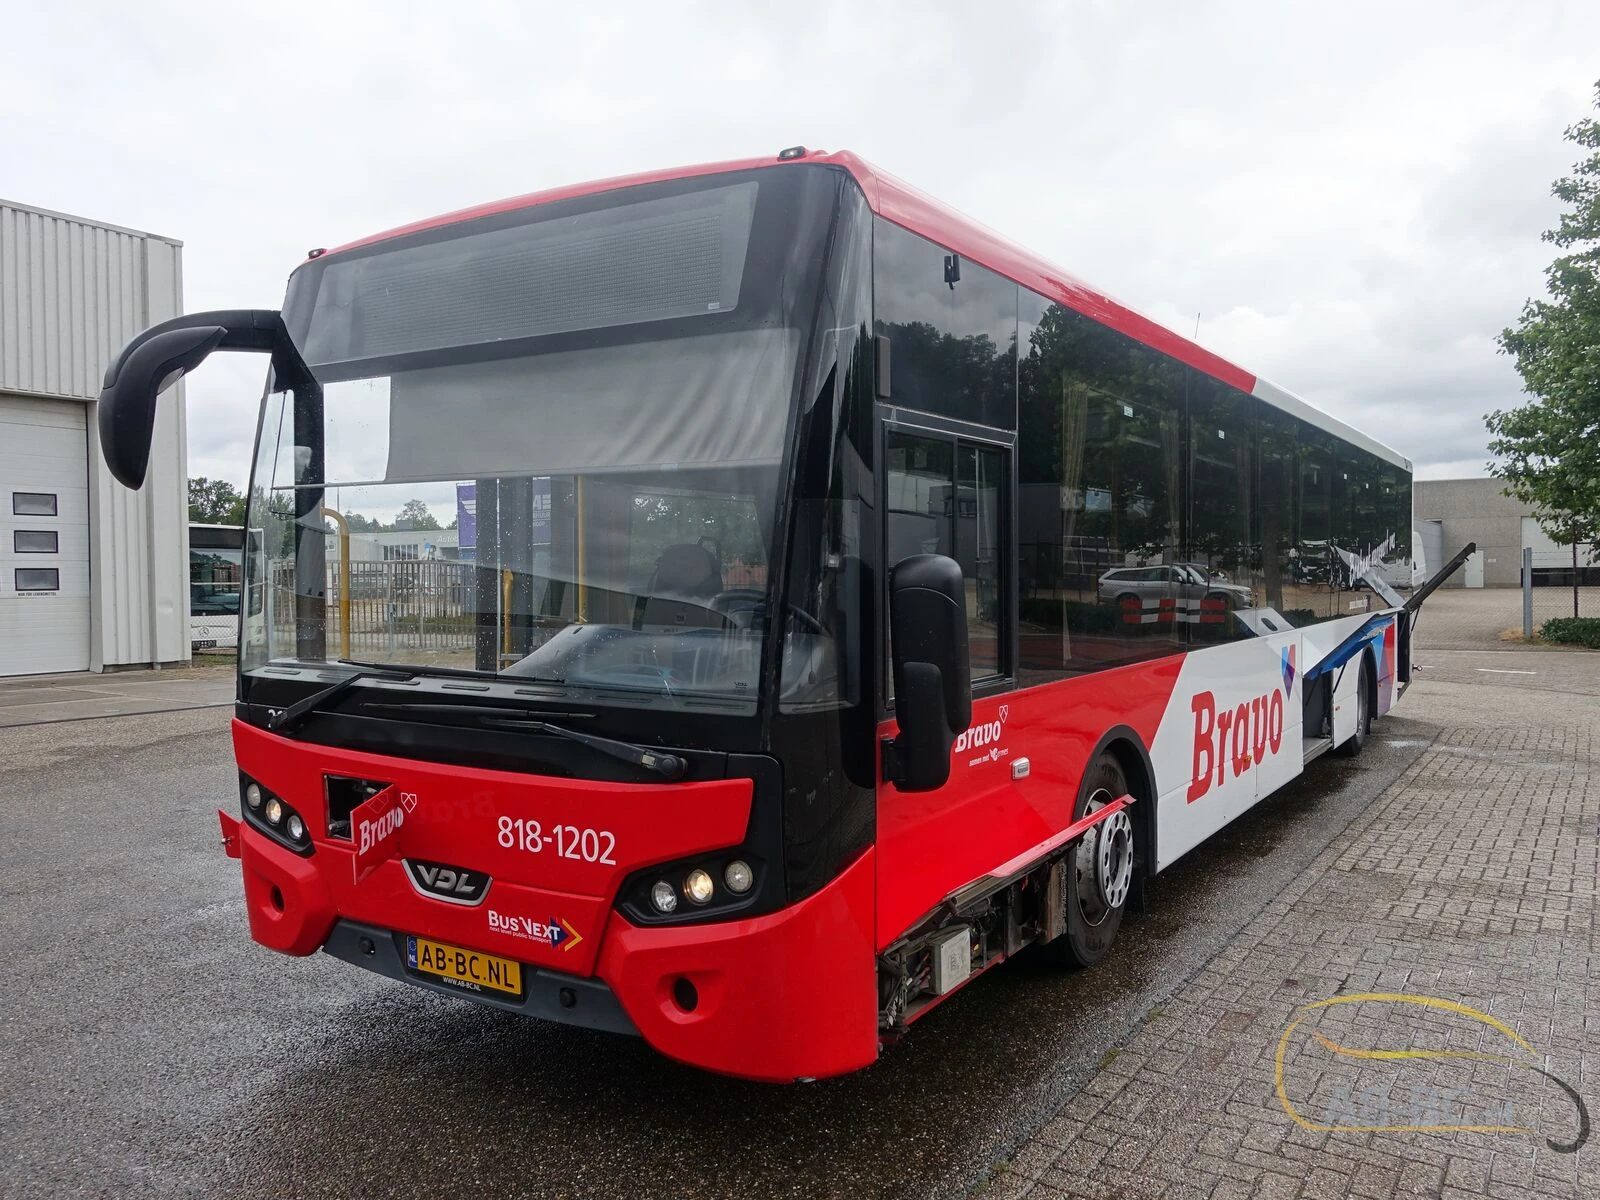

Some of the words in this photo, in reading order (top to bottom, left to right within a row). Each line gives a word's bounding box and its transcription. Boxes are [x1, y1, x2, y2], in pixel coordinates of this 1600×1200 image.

[955, 720, 1002, 753] Bravo
[1186, 687, 1284, 805] Bravo
[358, 806, 405, 856] Bravo
[497, 814, 617, 866] 818-1202
[416, 863, 477, 895] VDL
[500, 928, 512, 936] level
[512, 931, 528, 939] public
[528, 934, 553, 945] transport
[408, 953, 417, 963] NL
[421, 944, 515, 989] AB-BC.NL
[442, 975, 482, 992] WWW.AB-BC.NL
